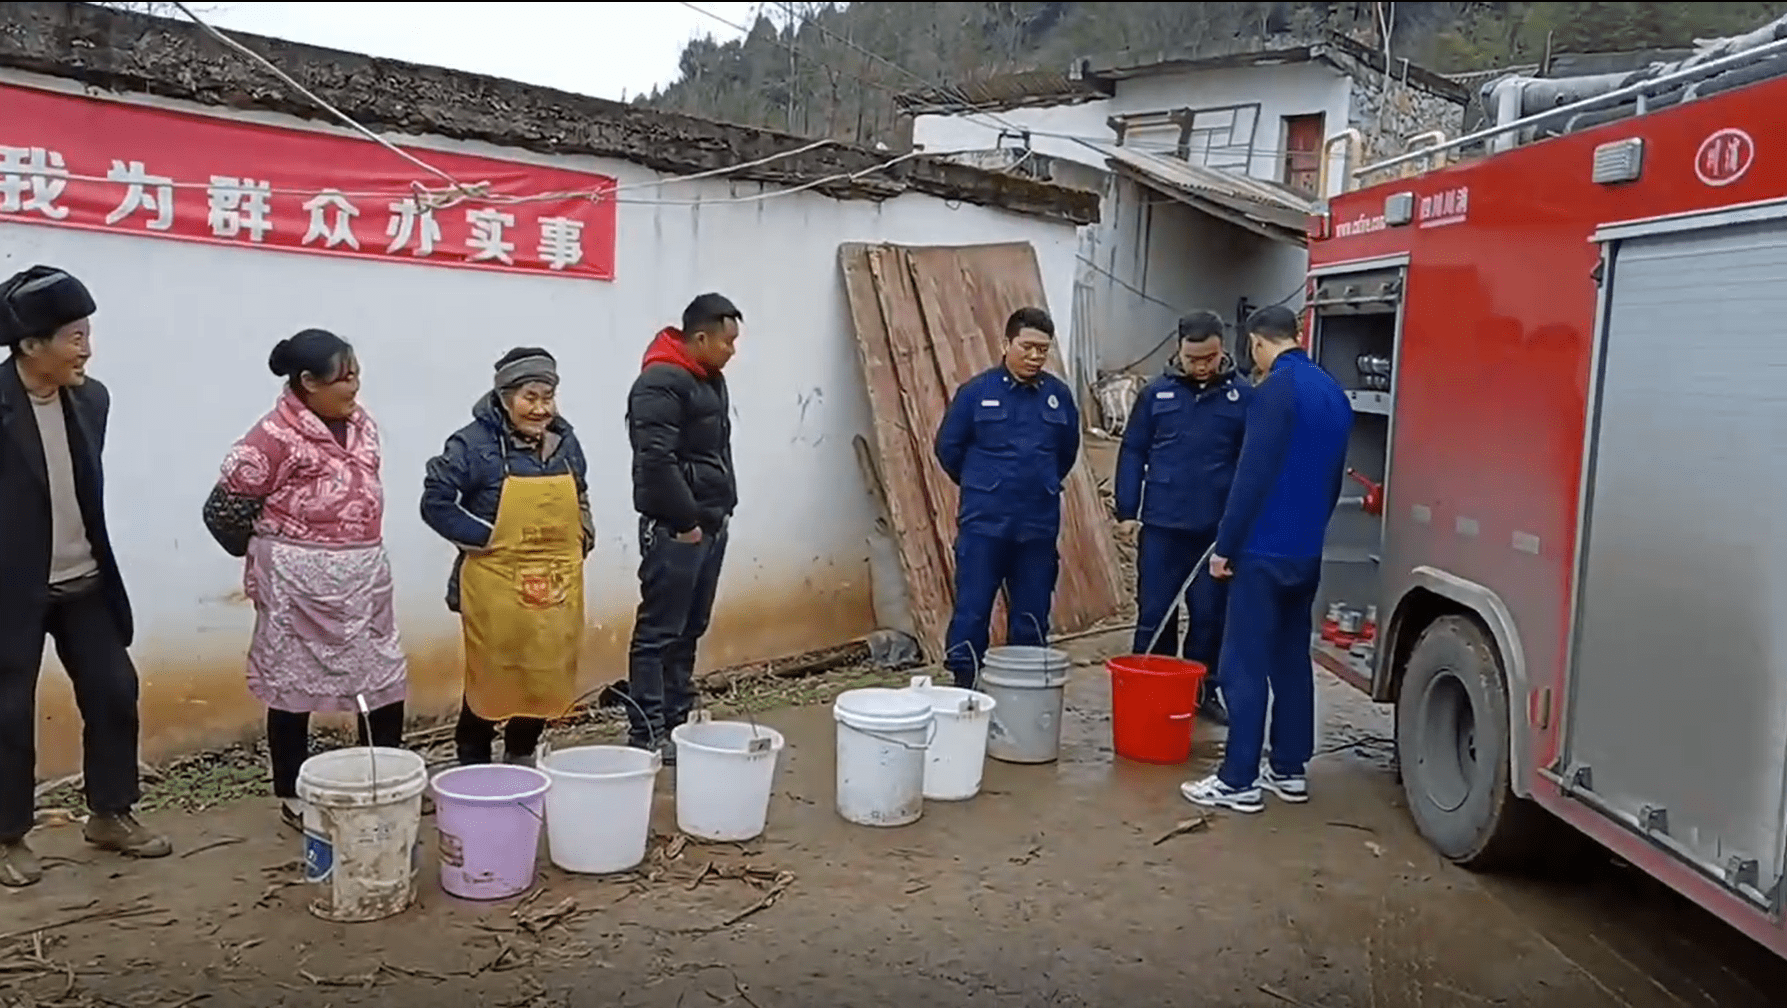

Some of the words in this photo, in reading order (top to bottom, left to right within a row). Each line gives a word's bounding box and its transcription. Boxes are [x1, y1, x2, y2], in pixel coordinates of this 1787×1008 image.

[0, 146, 584, 269] 我为群众办实事
